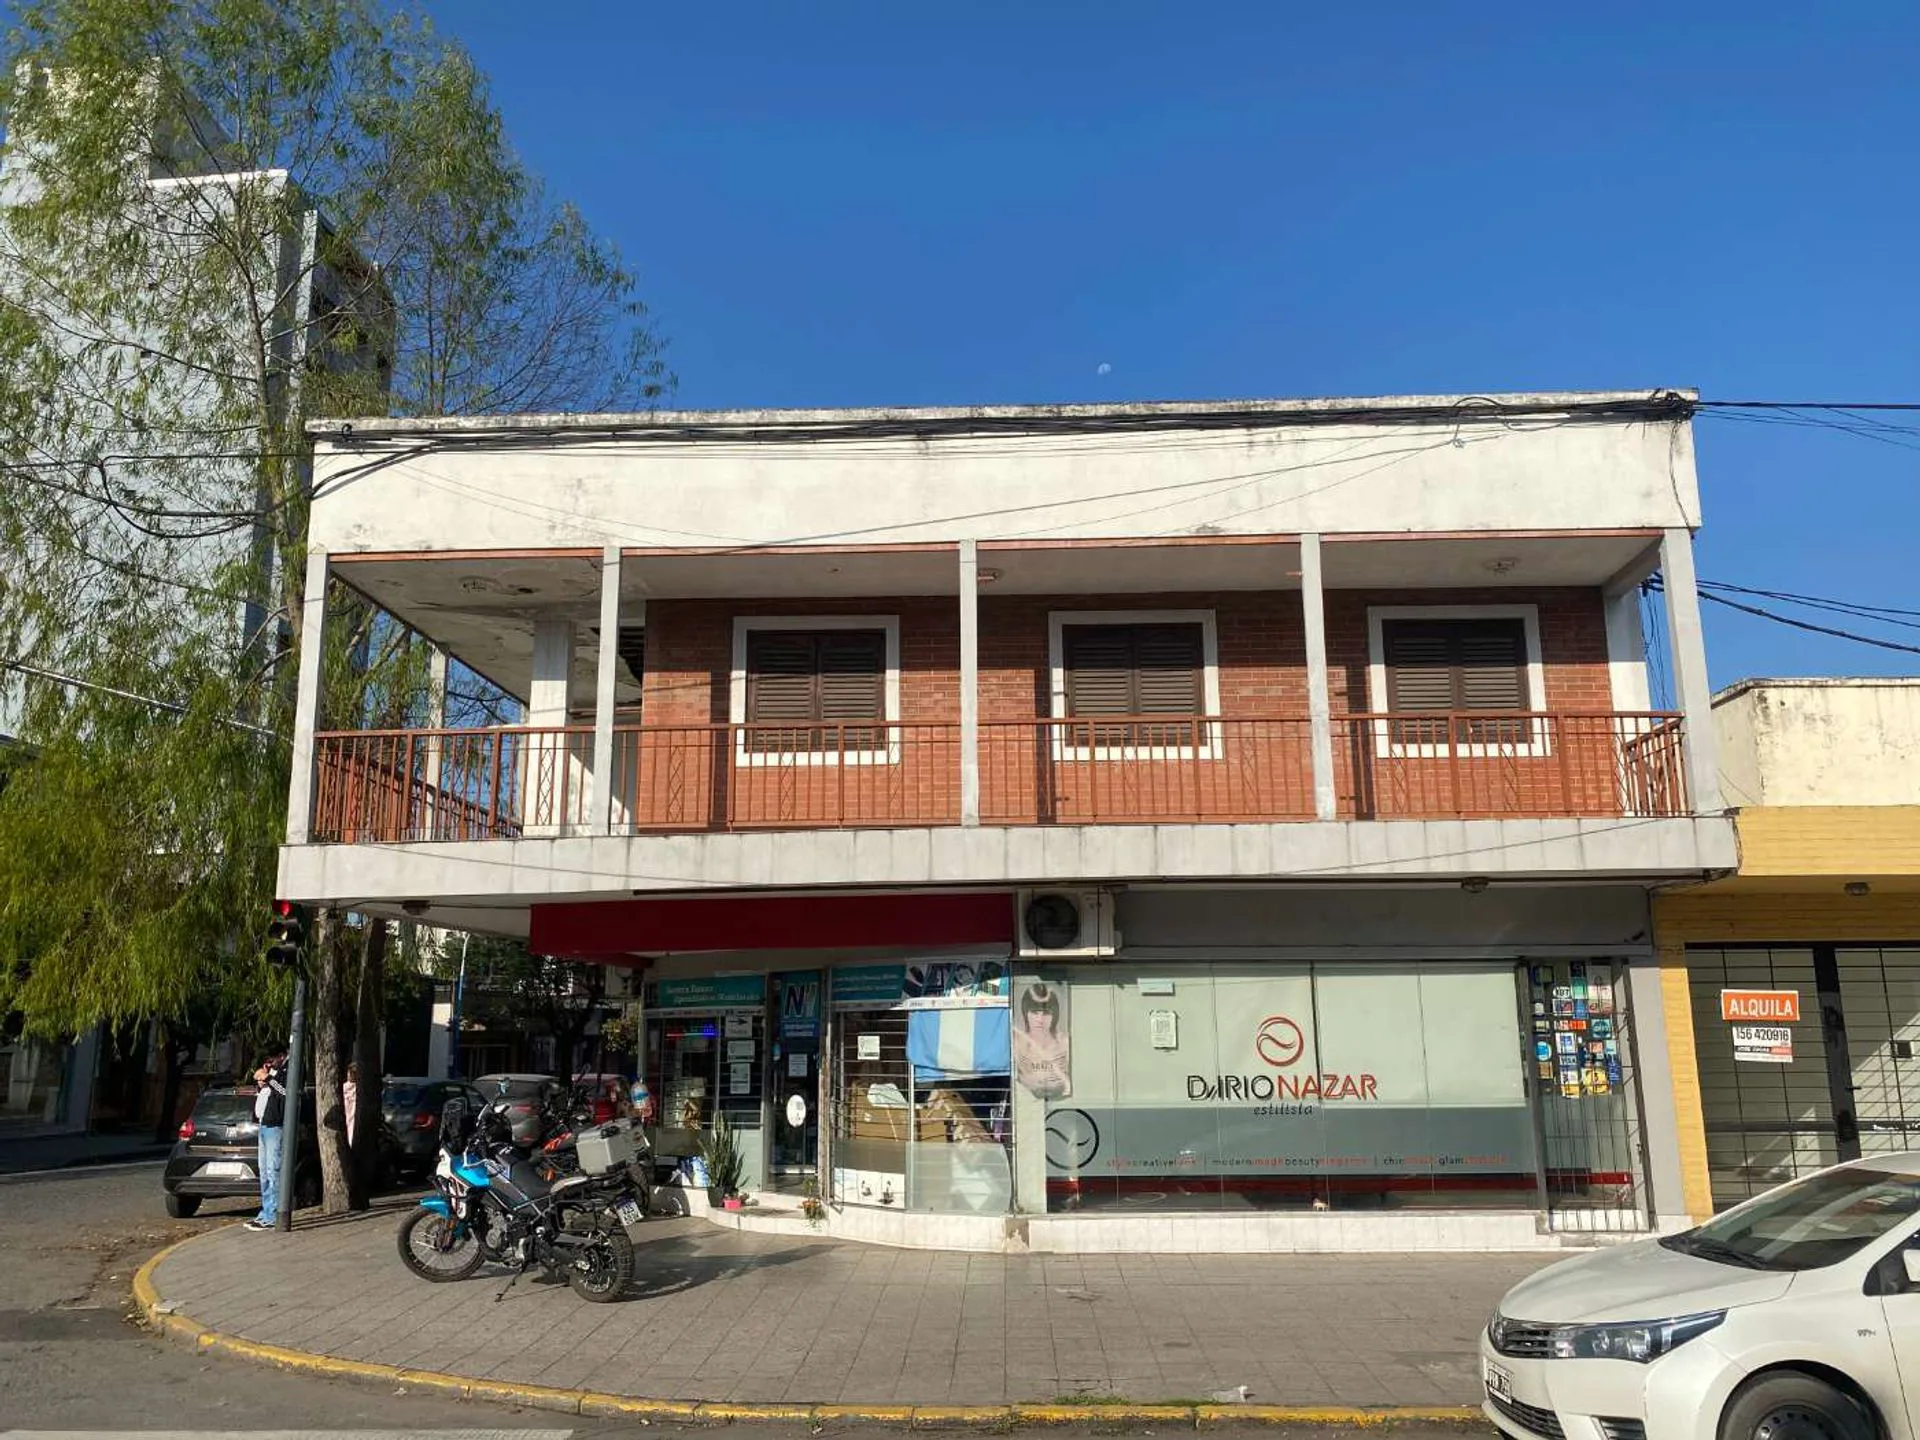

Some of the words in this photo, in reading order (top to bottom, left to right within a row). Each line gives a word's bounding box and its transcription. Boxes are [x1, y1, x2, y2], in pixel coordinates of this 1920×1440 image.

[1729, 998, 1794, 1017] ALQUILA
[1736, 1026, 1753, 1040] 156
[1187, 1075, 1275, 1100] DARIO
[1277, 1074, 1377, 1100] NAZAR
[1253, 1102, 1314, 1116] estilista
